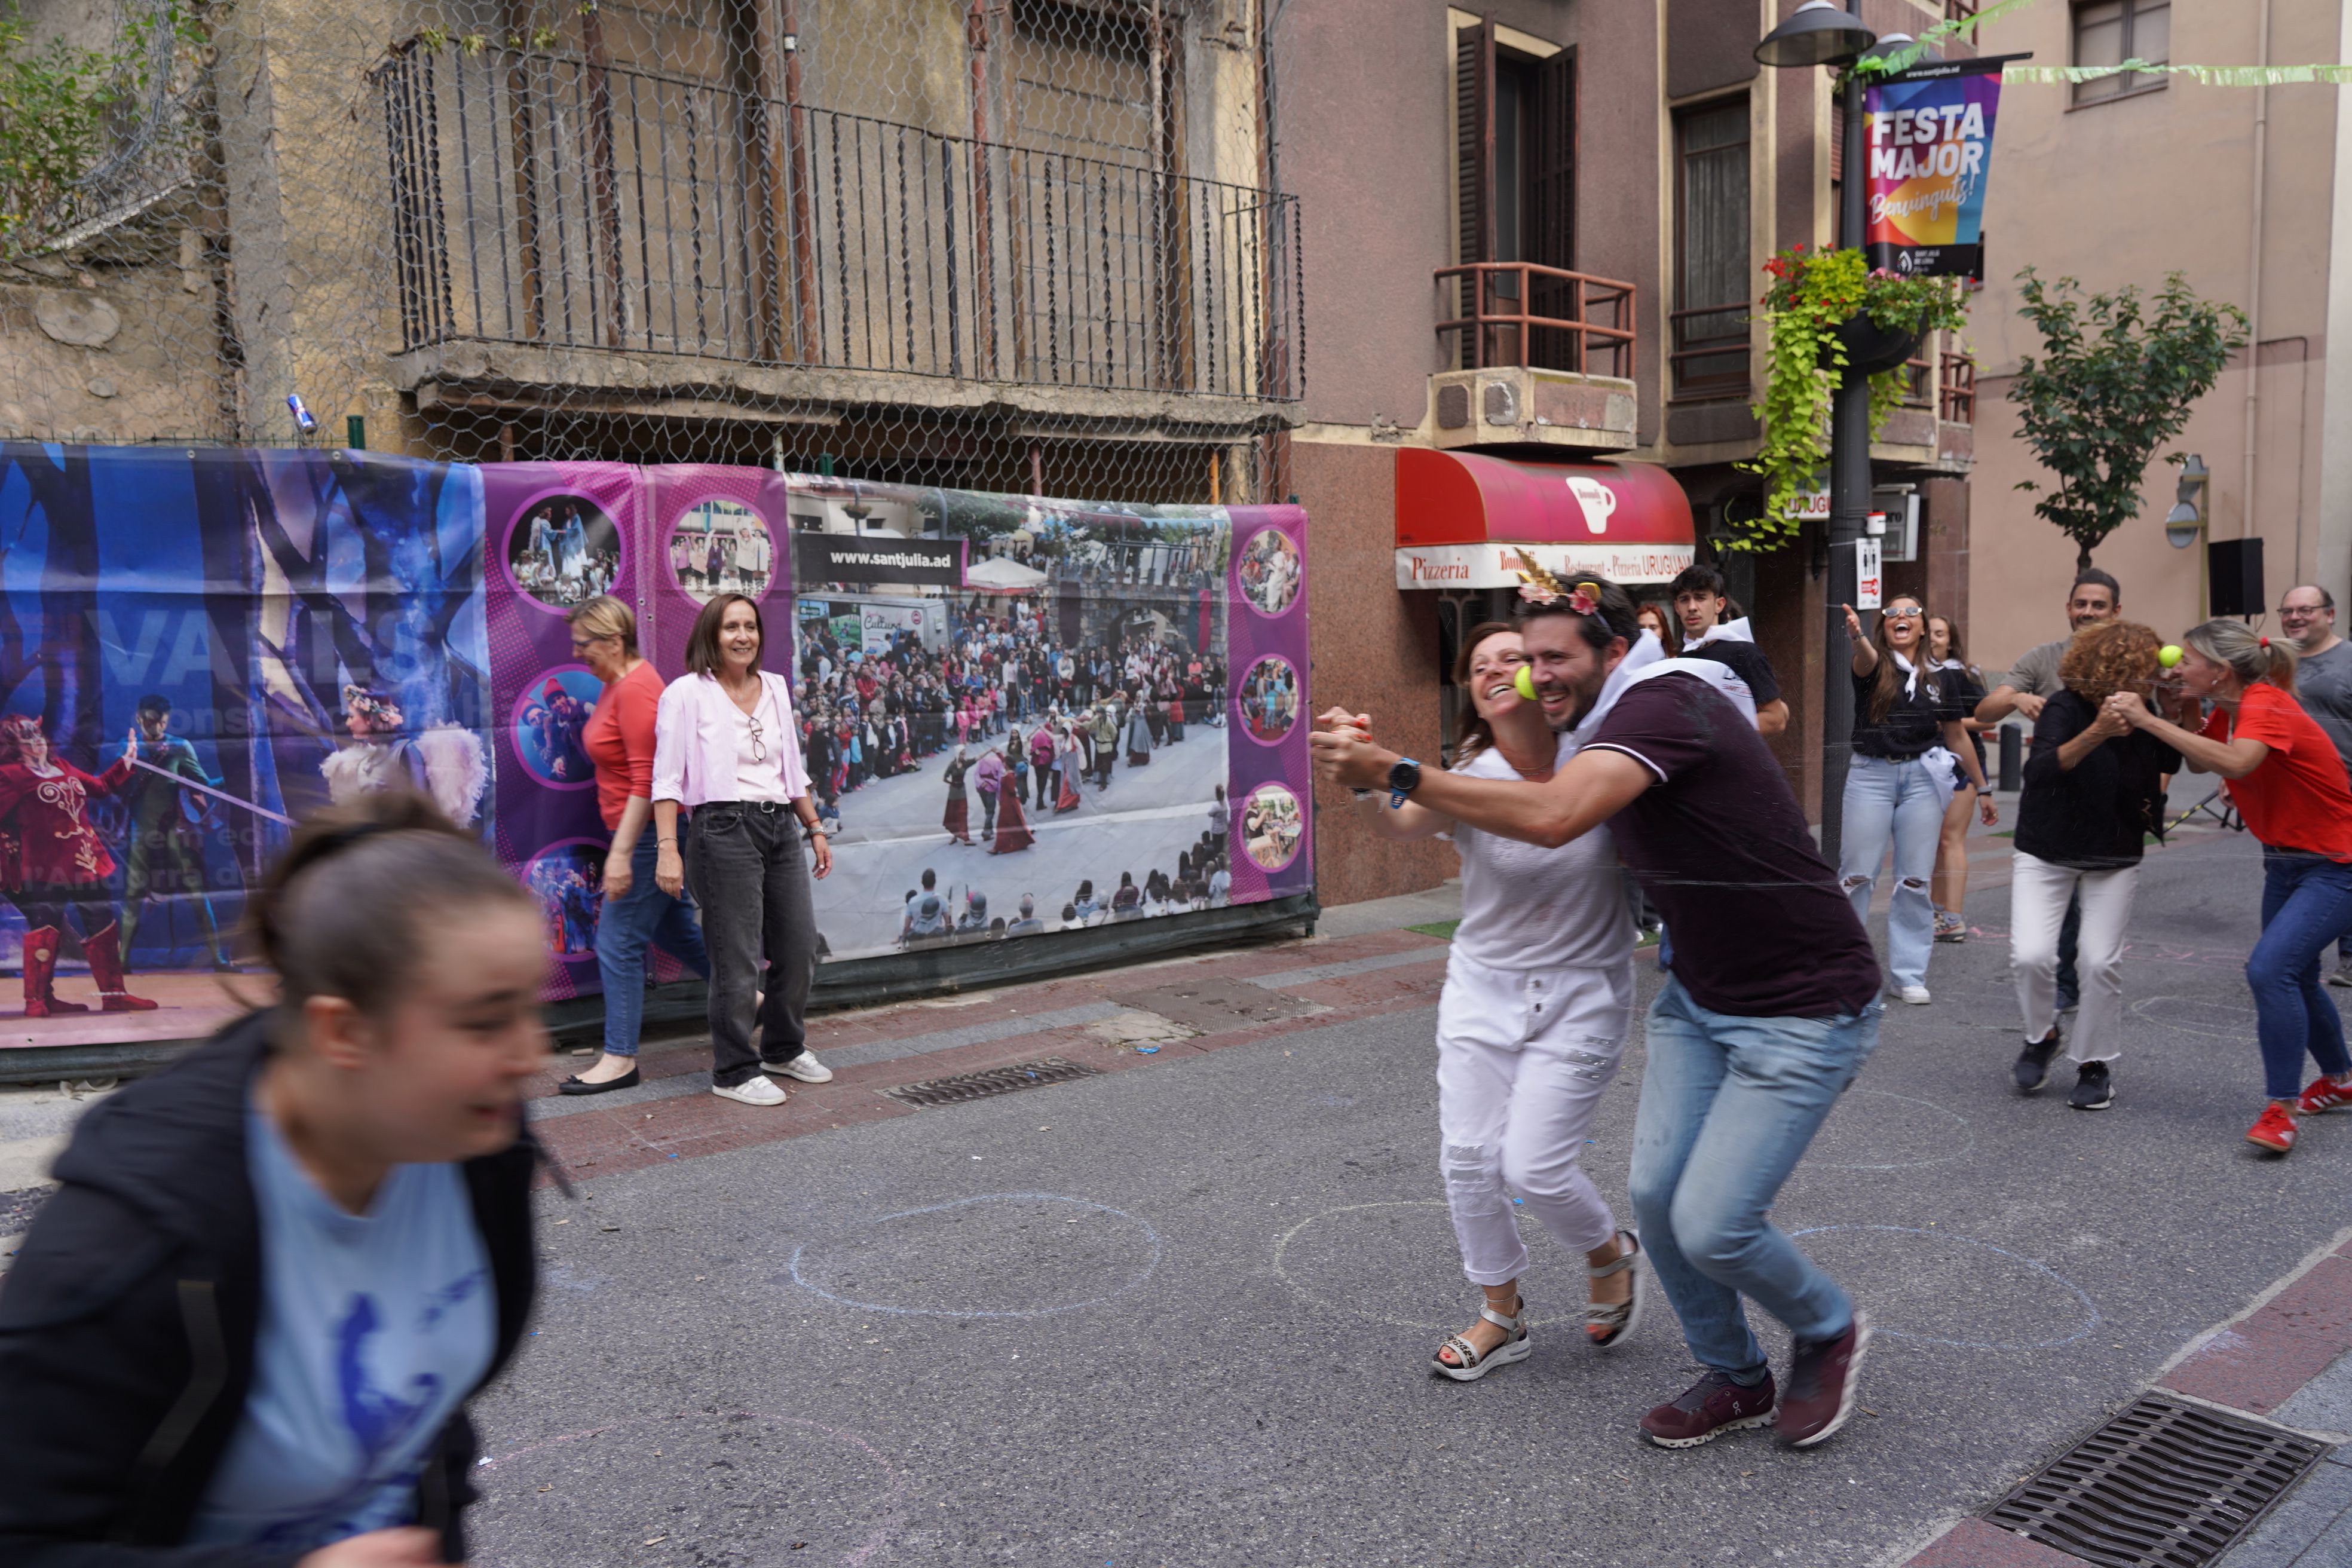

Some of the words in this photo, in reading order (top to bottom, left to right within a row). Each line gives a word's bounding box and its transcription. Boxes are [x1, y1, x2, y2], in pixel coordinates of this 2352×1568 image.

[1872, 102, 1985, 146] FESTA
[1870, 141, 1984, 180] MAJOR
[1869, 173, 1976, 225] Benvinguts!
[830, 552, 951, 568] www.santjulia.ad
[1413, 556, 1469, 580] Pizzeria
[1612, 555, 1642, 577] Pizzeria
